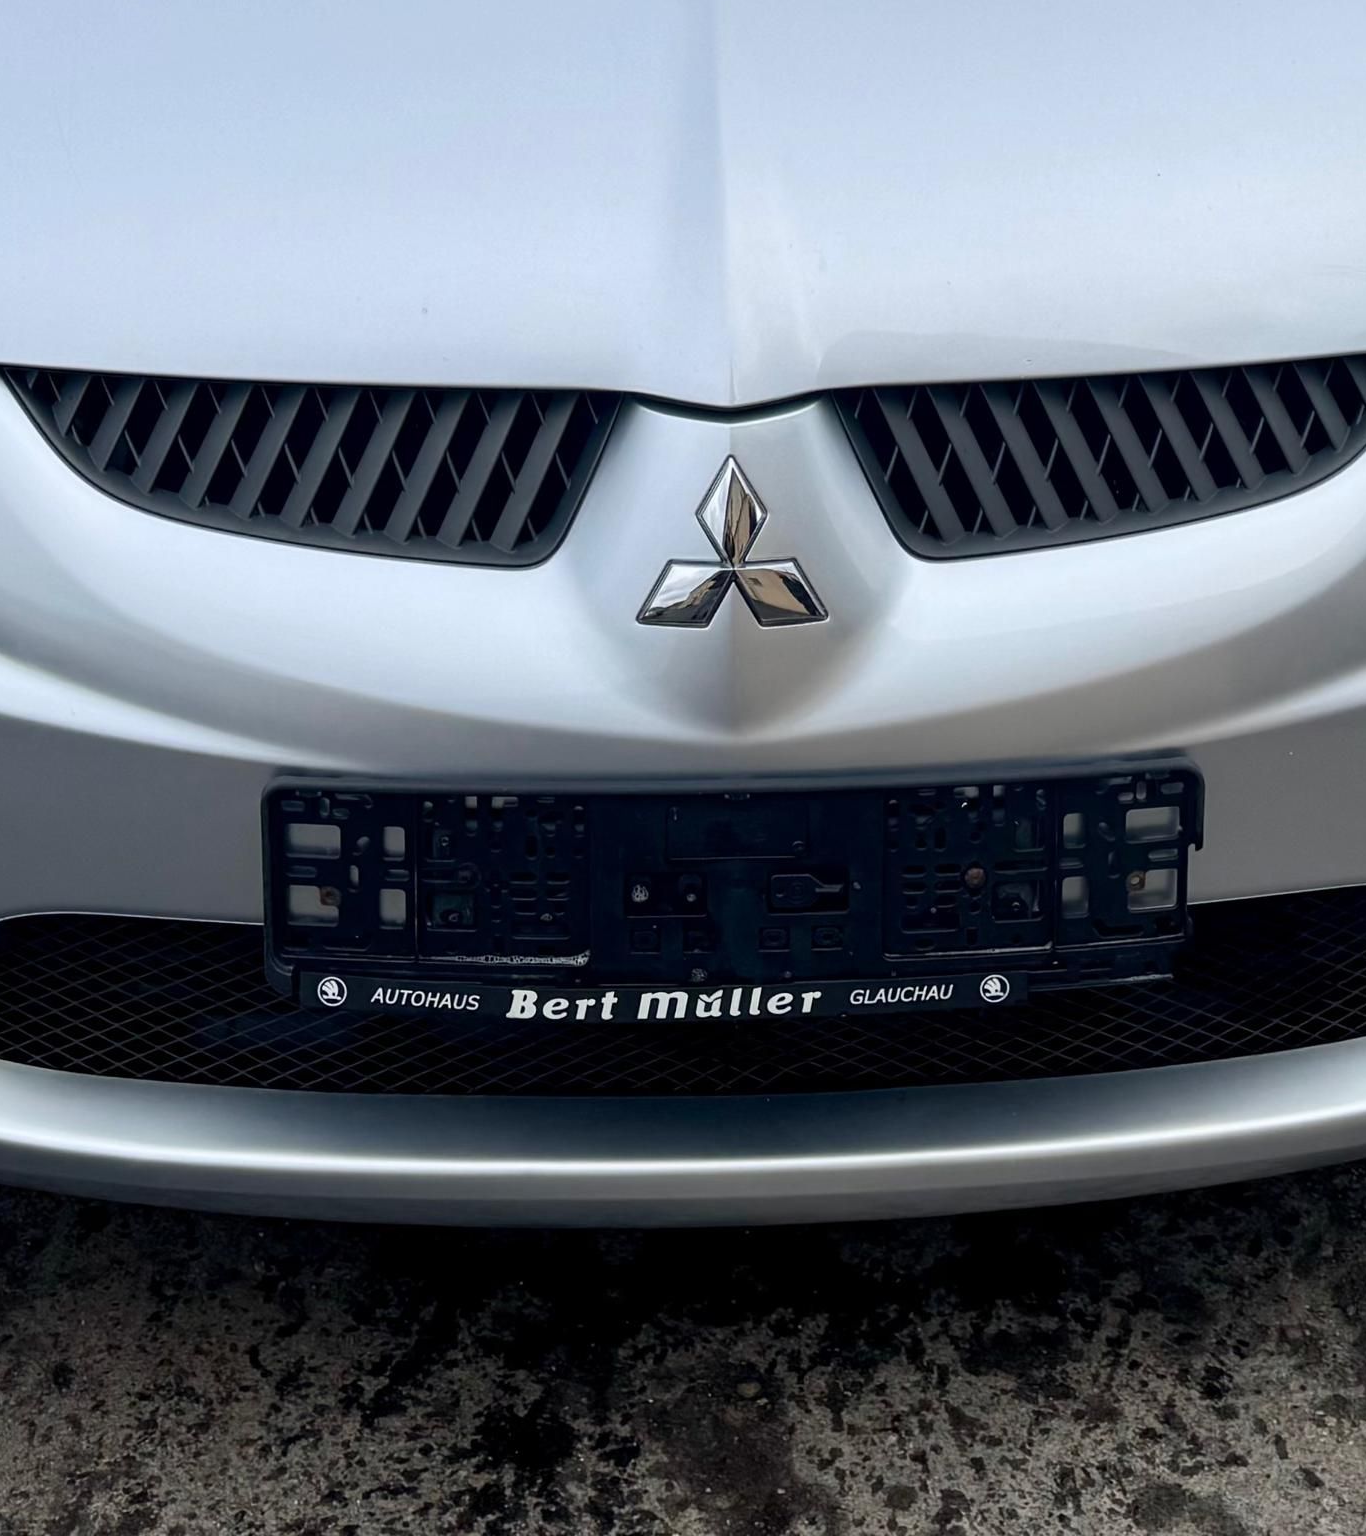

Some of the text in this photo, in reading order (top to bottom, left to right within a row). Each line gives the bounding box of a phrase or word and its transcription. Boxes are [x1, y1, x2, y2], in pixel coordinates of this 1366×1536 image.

[371, 987, 480, 1011] AUTOHAUS
[505, 989, 618, 1021] Bert
[849, 984, 953, 1005] GLAUCHAU
